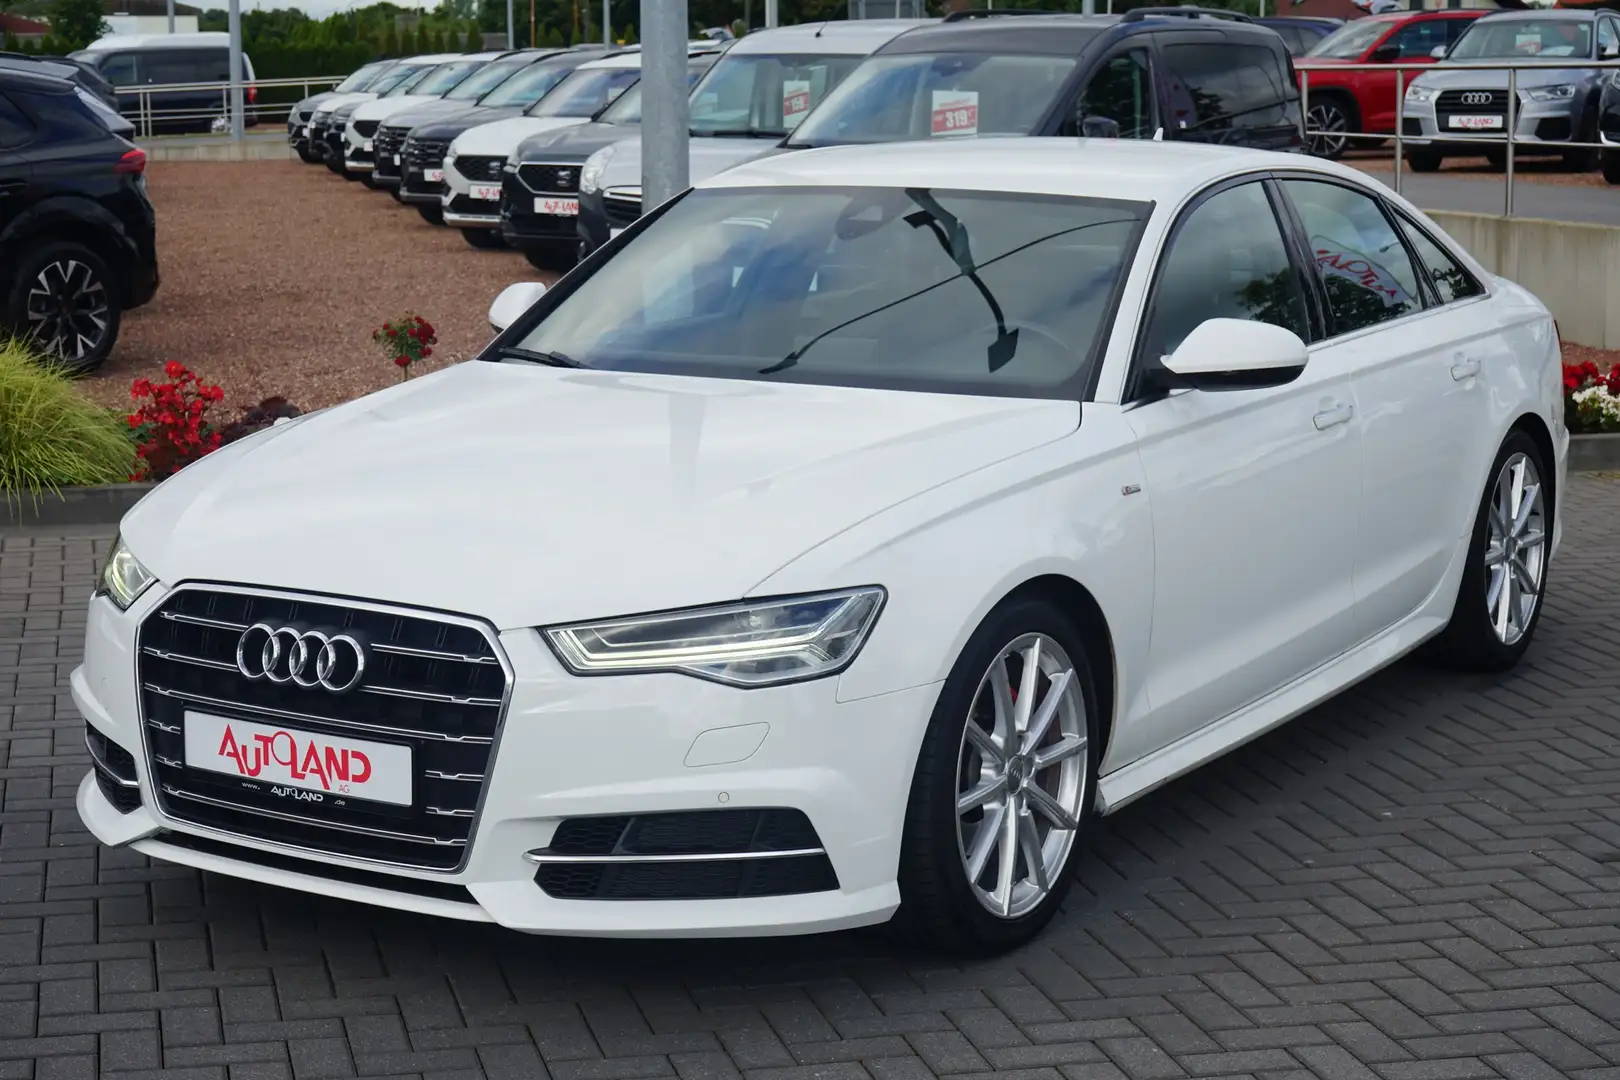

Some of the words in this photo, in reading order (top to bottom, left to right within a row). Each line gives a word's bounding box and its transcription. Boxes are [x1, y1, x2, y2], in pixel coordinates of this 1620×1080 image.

[218, 723, 372, 790] AUTOLAND
[338, 784, 350, 794] AG
[241, 781, 261, 790] www.
[271, 785, 323, 802] AUTOLAND
